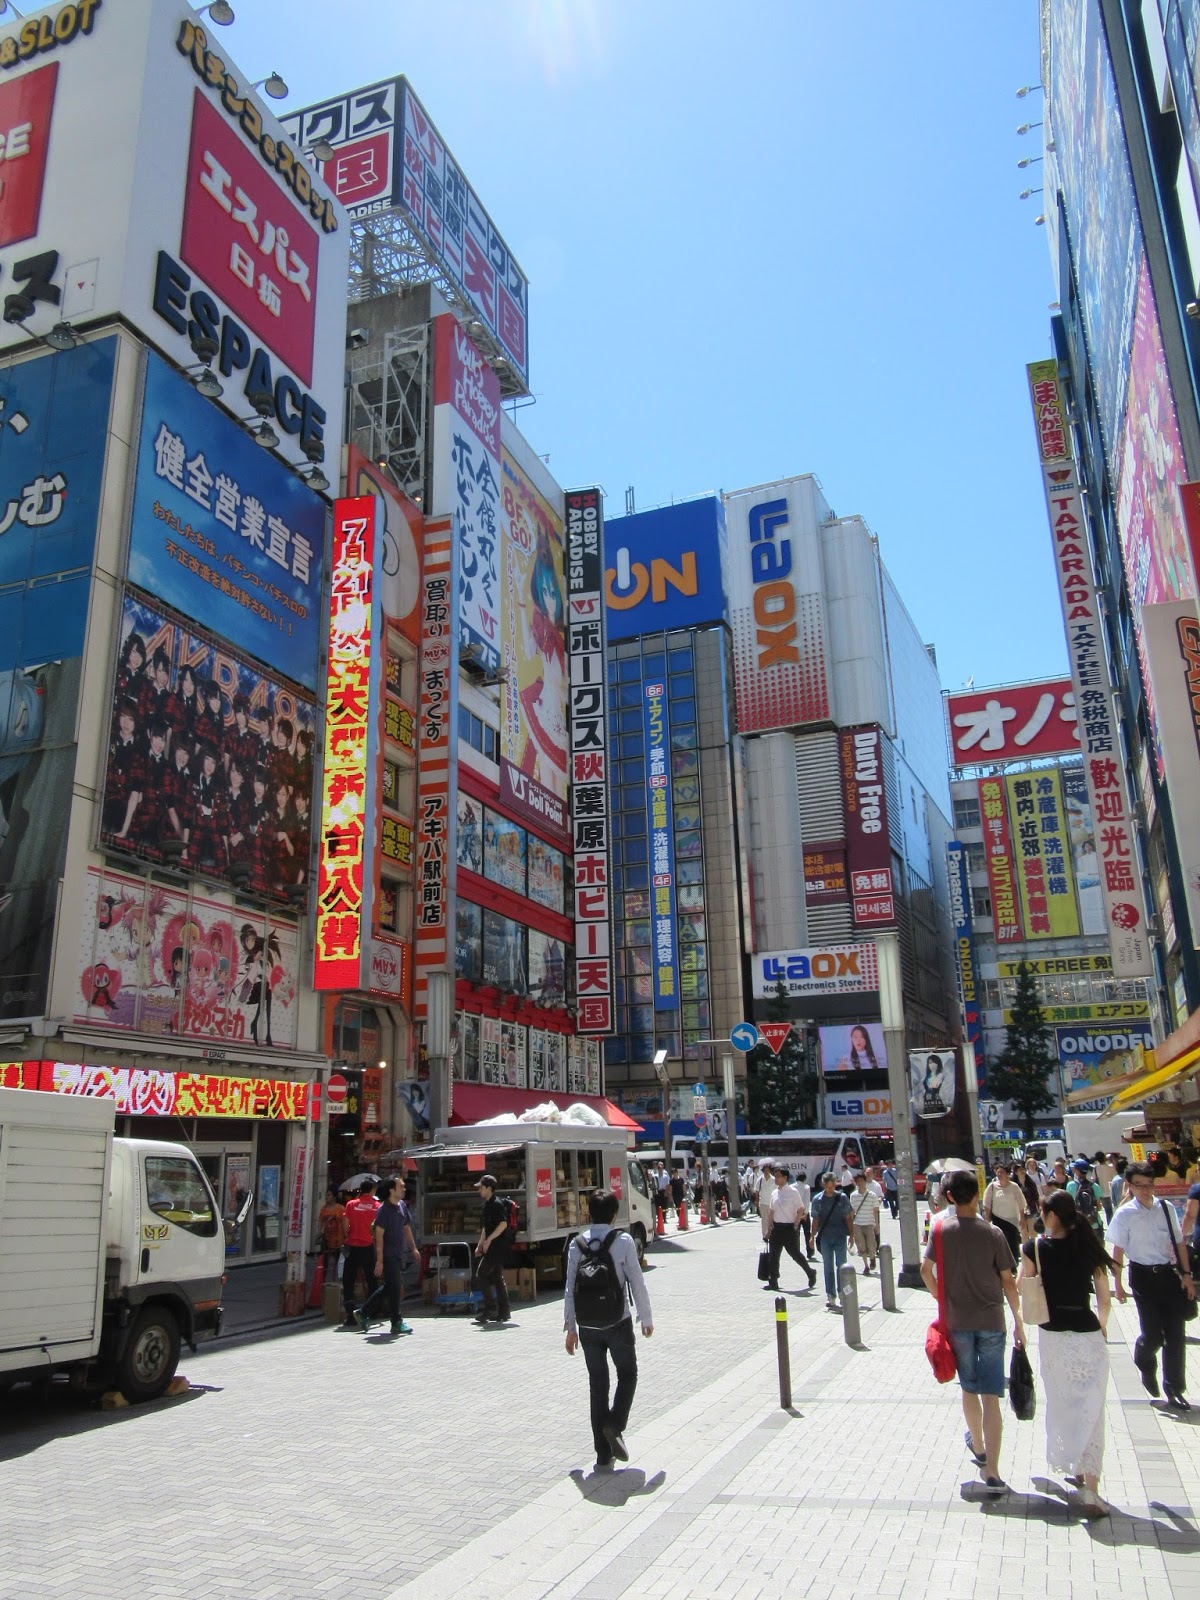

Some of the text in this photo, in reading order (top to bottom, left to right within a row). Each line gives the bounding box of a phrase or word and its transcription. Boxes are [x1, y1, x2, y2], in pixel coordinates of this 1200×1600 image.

[200, 150, 312, 302] エスパス
[153, 250, 326, 450] ESPACE
[1032, 379, 1067, 458] まんが喫茶
[154, 423, 314, 585] 健全営業宣言
[583, 493, 598, 556] HOBBY
[568, 496, 584, 590] PARADISE
[1052, 497, 1093, 621] TAKARADA
[425, 578, 448, 637] 買取り
[424, 668, 446, 744] まっくす
[1080, 688, 1114, 754] 免税商店
[842, 735, 857, 812] Flagship Store
[854, 731, 883, 834] Duty Free
[981, 783, 1004, 819] 免税
[528, 788, 563, 826] Doll Point
[1034, 776, 1069, 896] 冷蔵庫 洗濯機
[422, 798, 444, 926] アキバ駅前店
[647, 685, 674, 996] 6F エアコン・季節 5F 冷蔵庫・洗濯機 4F 調理・理美容・健康
[855, 873, 888, 890] 免税
[857, 902, 892, 916] 면세점
[947, 850, 967, 928] Panasonic
[997, 926, 1018, 939] B1F
[763, 978, 862, 994] Hoe Electronics Store
[957, 937, 976, 1002] ONODEN
[1005, 960, 1041, 976] TAX
[1044, 957, 1091, 973] FREE
[764, 1027, 786, 1037] 止まれ
[1052, 1006, 1092, 1020] 冷蔵庫
[1096, 1003, 1148, 1017] エアコン
[209, 1051, 226, 1059] ESPACE
